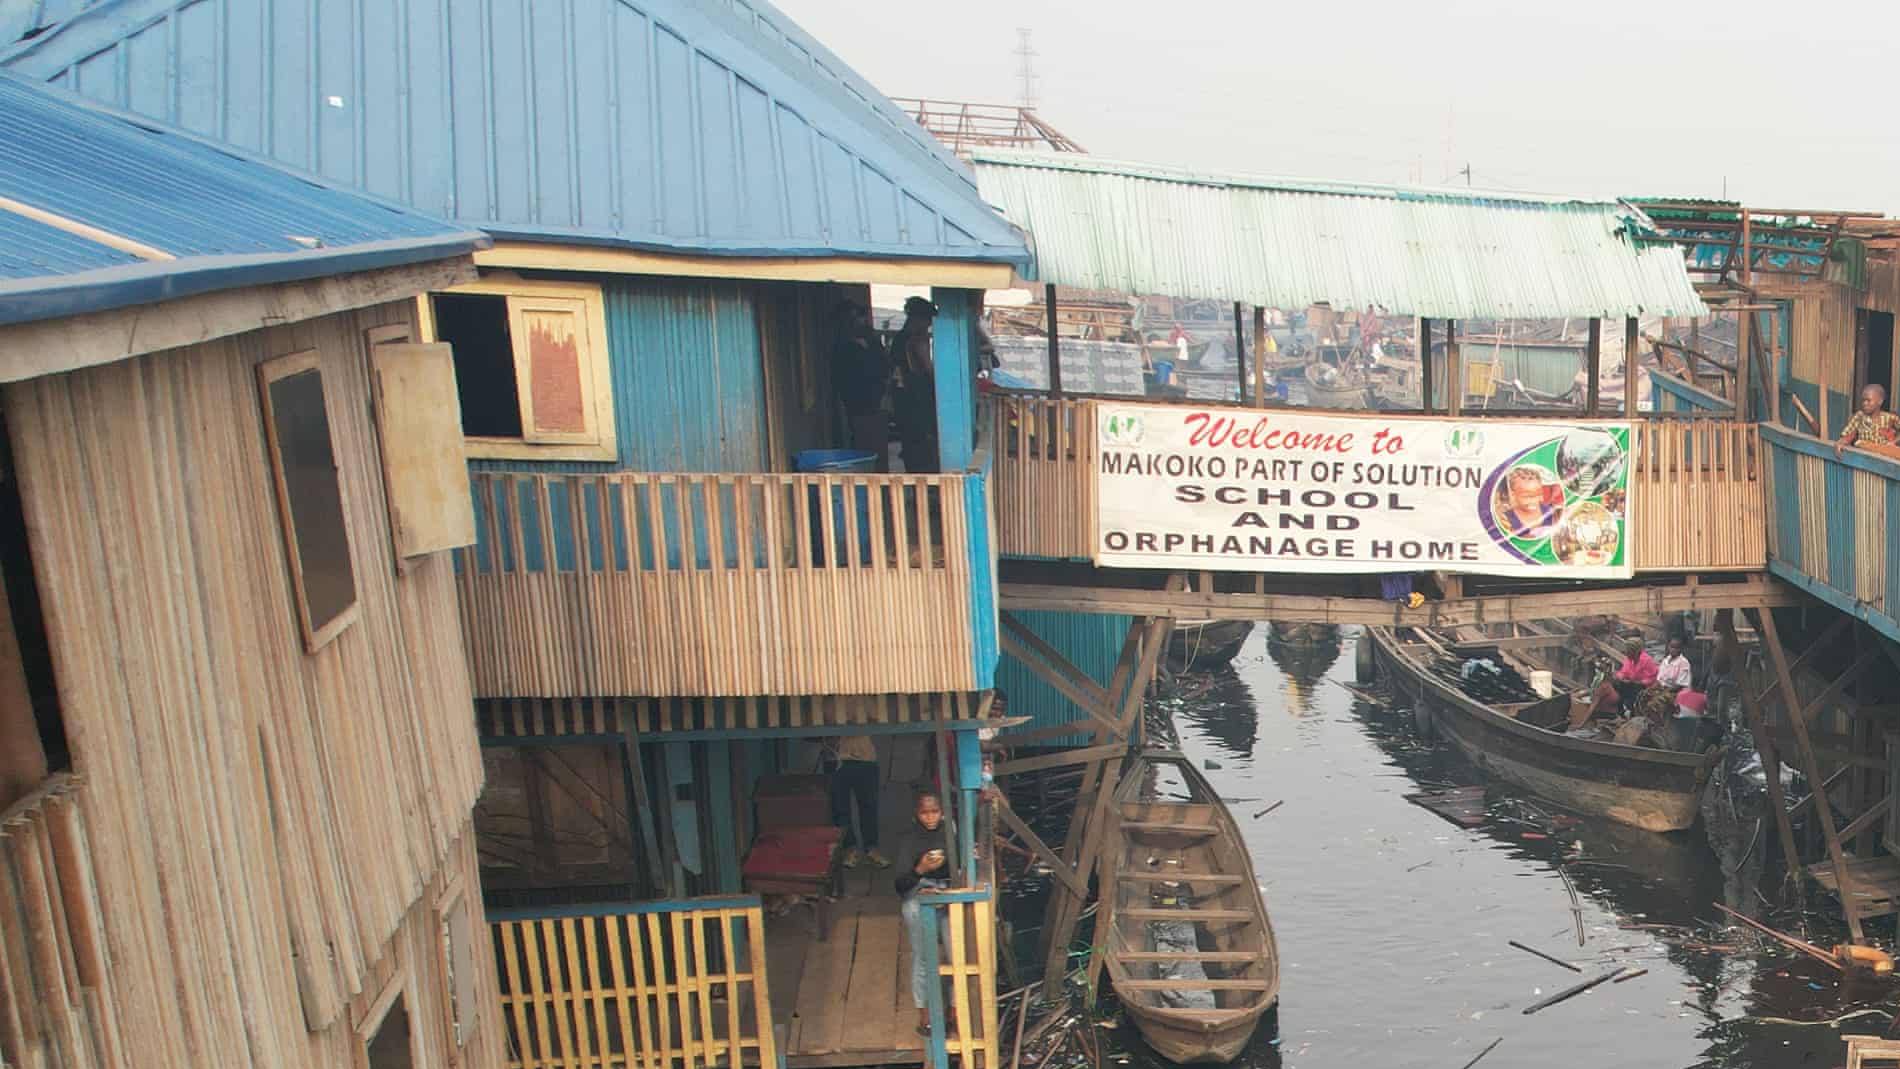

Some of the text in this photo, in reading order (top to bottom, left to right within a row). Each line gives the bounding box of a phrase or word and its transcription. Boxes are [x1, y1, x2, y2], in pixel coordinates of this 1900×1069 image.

[1184, 412, 1405, 454] Welcome to
[1102, 452, 1482, 488] MAKOKO PART OF SOLUTION
[1175, 484, 1415, 510] SCHOOL
[1231, 511, 1361, 531] AND
[1104, 531, 1479, 561] ORPHANAGE HOME
